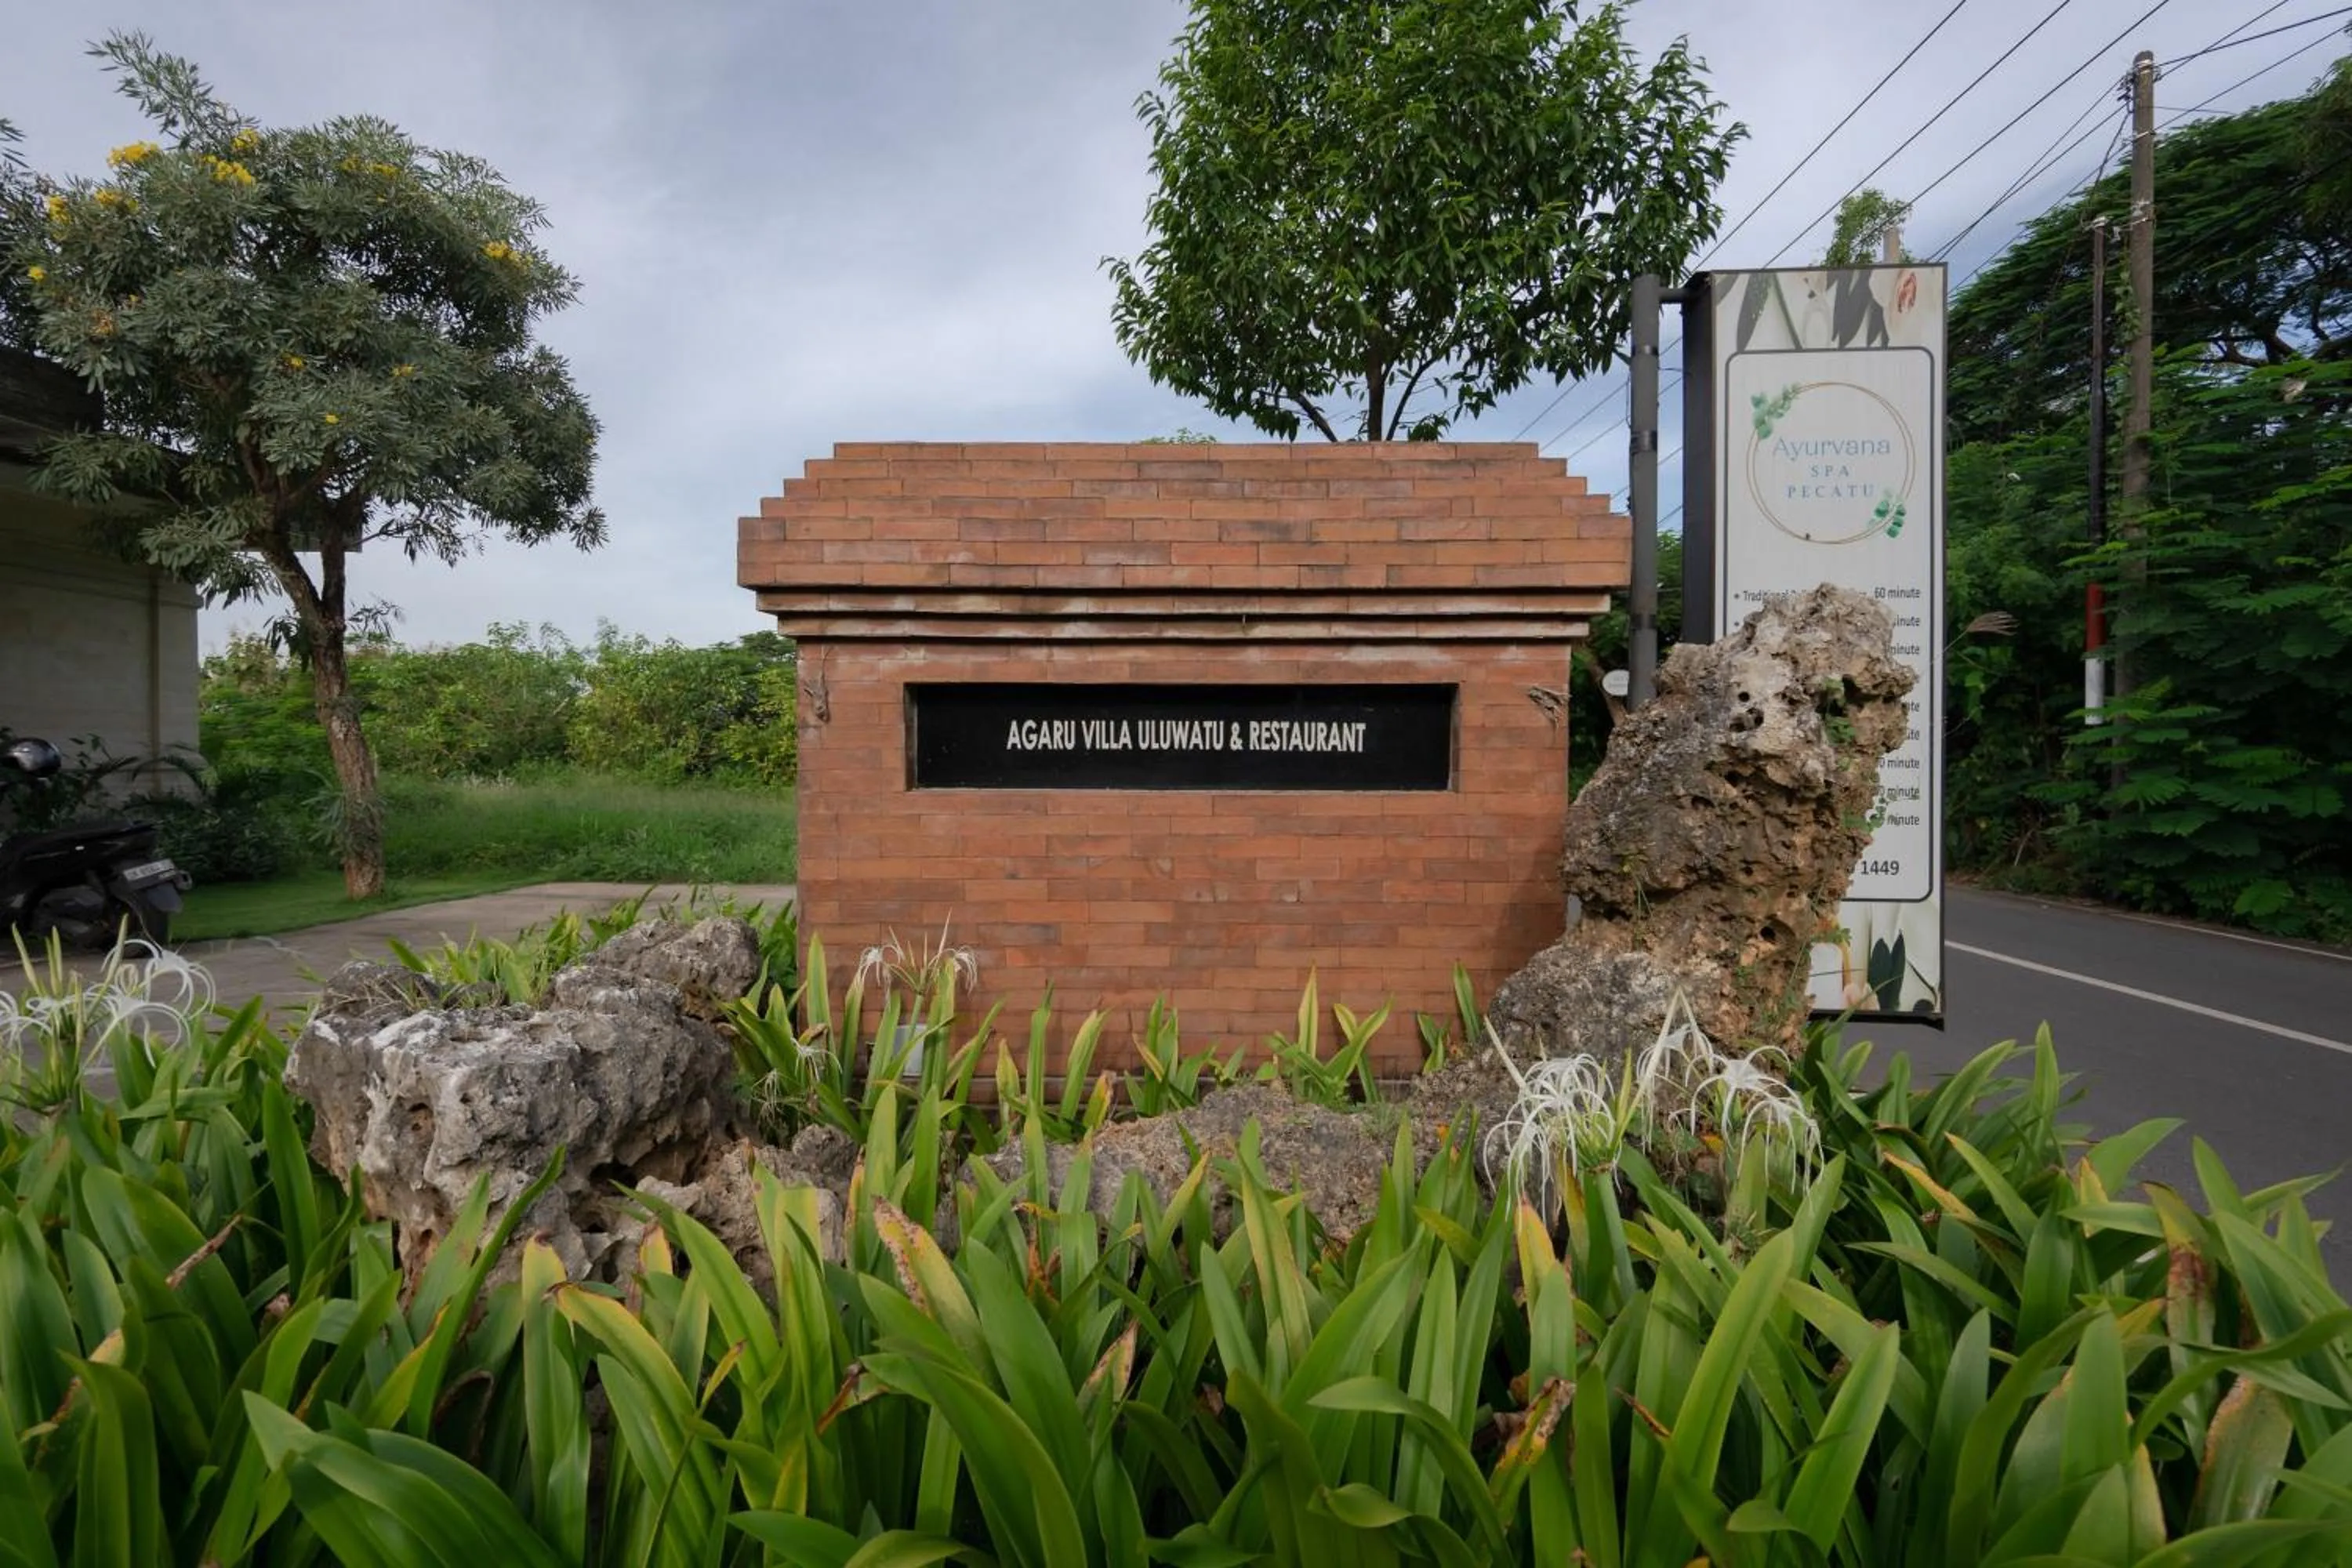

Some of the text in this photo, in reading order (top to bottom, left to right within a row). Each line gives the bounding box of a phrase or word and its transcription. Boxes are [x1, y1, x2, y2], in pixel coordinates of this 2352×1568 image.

[1772, 437, 1891, 462] Ayurvana
[1810, 464, 1849, 477] SPA
[1787, 484, 1875, 498] PECATU
[1888, 586, 1920, 598] minute
[1892, 615, 1920, 626] inute
[1007, 719, 1367, 753] AGARU VILLA ULUWATU & RESTAURANT
[1887, 757, 1920, 768] minute
[1860, 860, 1900, 876] 1449
